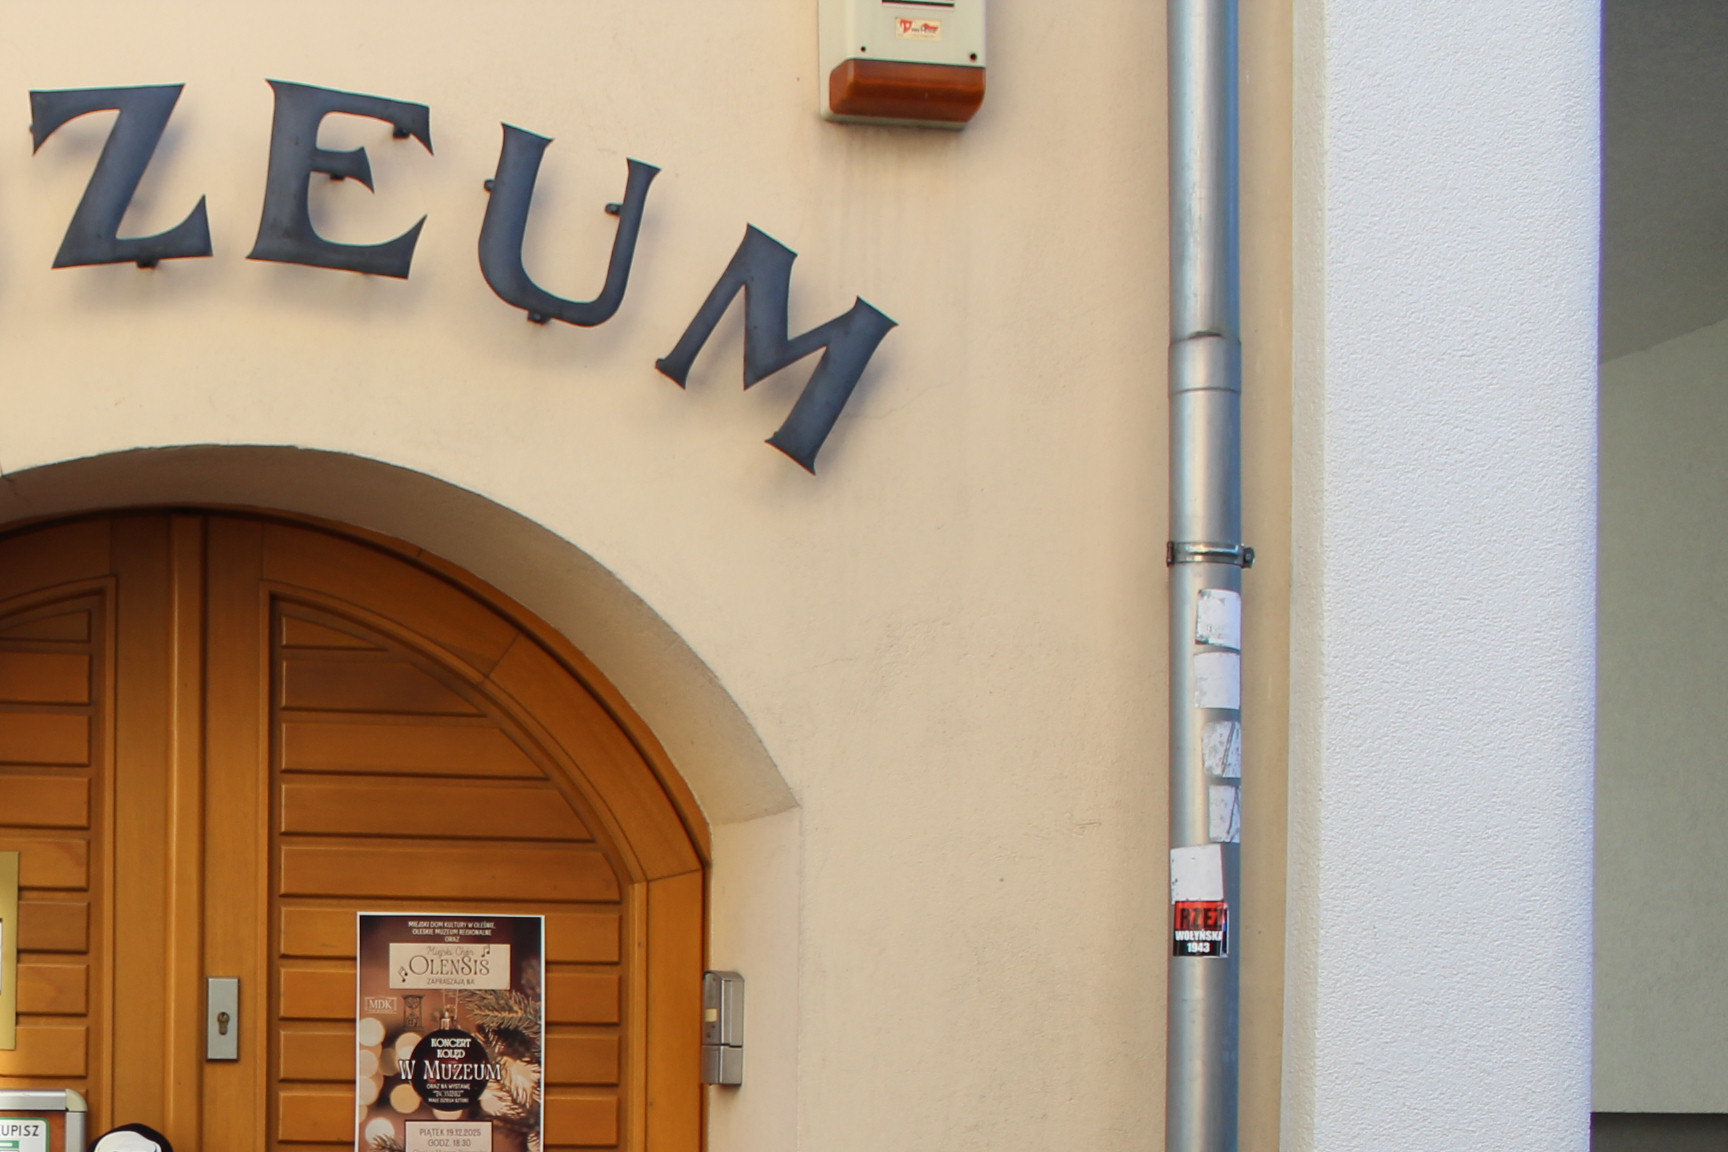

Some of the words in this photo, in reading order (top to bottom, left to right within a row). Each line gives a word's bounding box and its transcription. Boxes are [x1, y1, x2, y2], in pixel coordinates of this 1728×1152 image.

[1174, 929, 1223, 941] WOŁYŃSKA
[1186, 942, 1210, 953] 1943
[369, 999, 392, 1009] MDK
[431, 1038, 472, 1047] KONCERT
[437, 1049, 465, 1060] KOLĘD
[399, 1060, 415, 1080] W
[423, 1060, 502, 1080] MUZEUM
[419, 1127, 444, 1137] PIĄTEK
